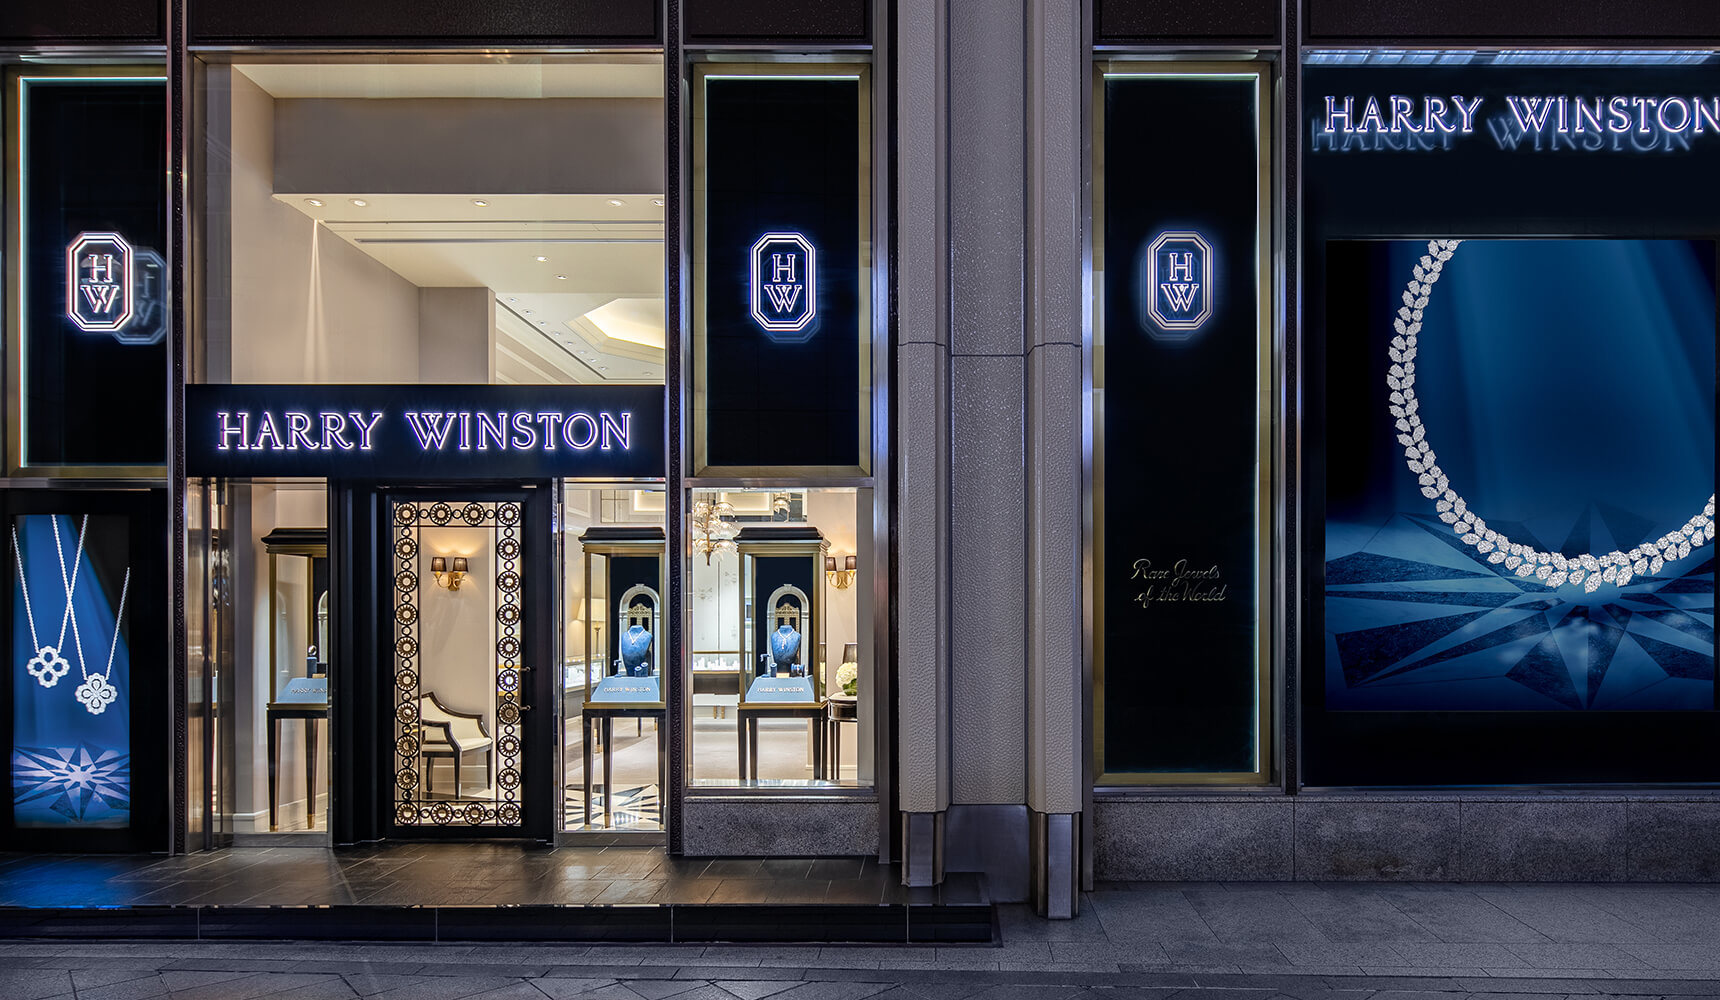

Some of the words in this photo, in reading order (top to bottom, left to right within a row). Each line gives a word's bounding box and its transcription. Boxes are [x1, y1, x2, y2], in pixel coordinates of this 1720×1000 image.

[1324, 95, 1484, 133] HARRY
[1506, 95, 1720, 133] WINSTON
[217, 411, 383, 450] HARRY
[405, 411, 631, 450] WINSTON
[1130, 558, 1171, 580] Rare
[1171, 558, 1220, 587] Jewels
[1133, 584, 1154, 609] of
[1155, 585, 1180, 602] the
[1181, 580, 1228, 602] World
